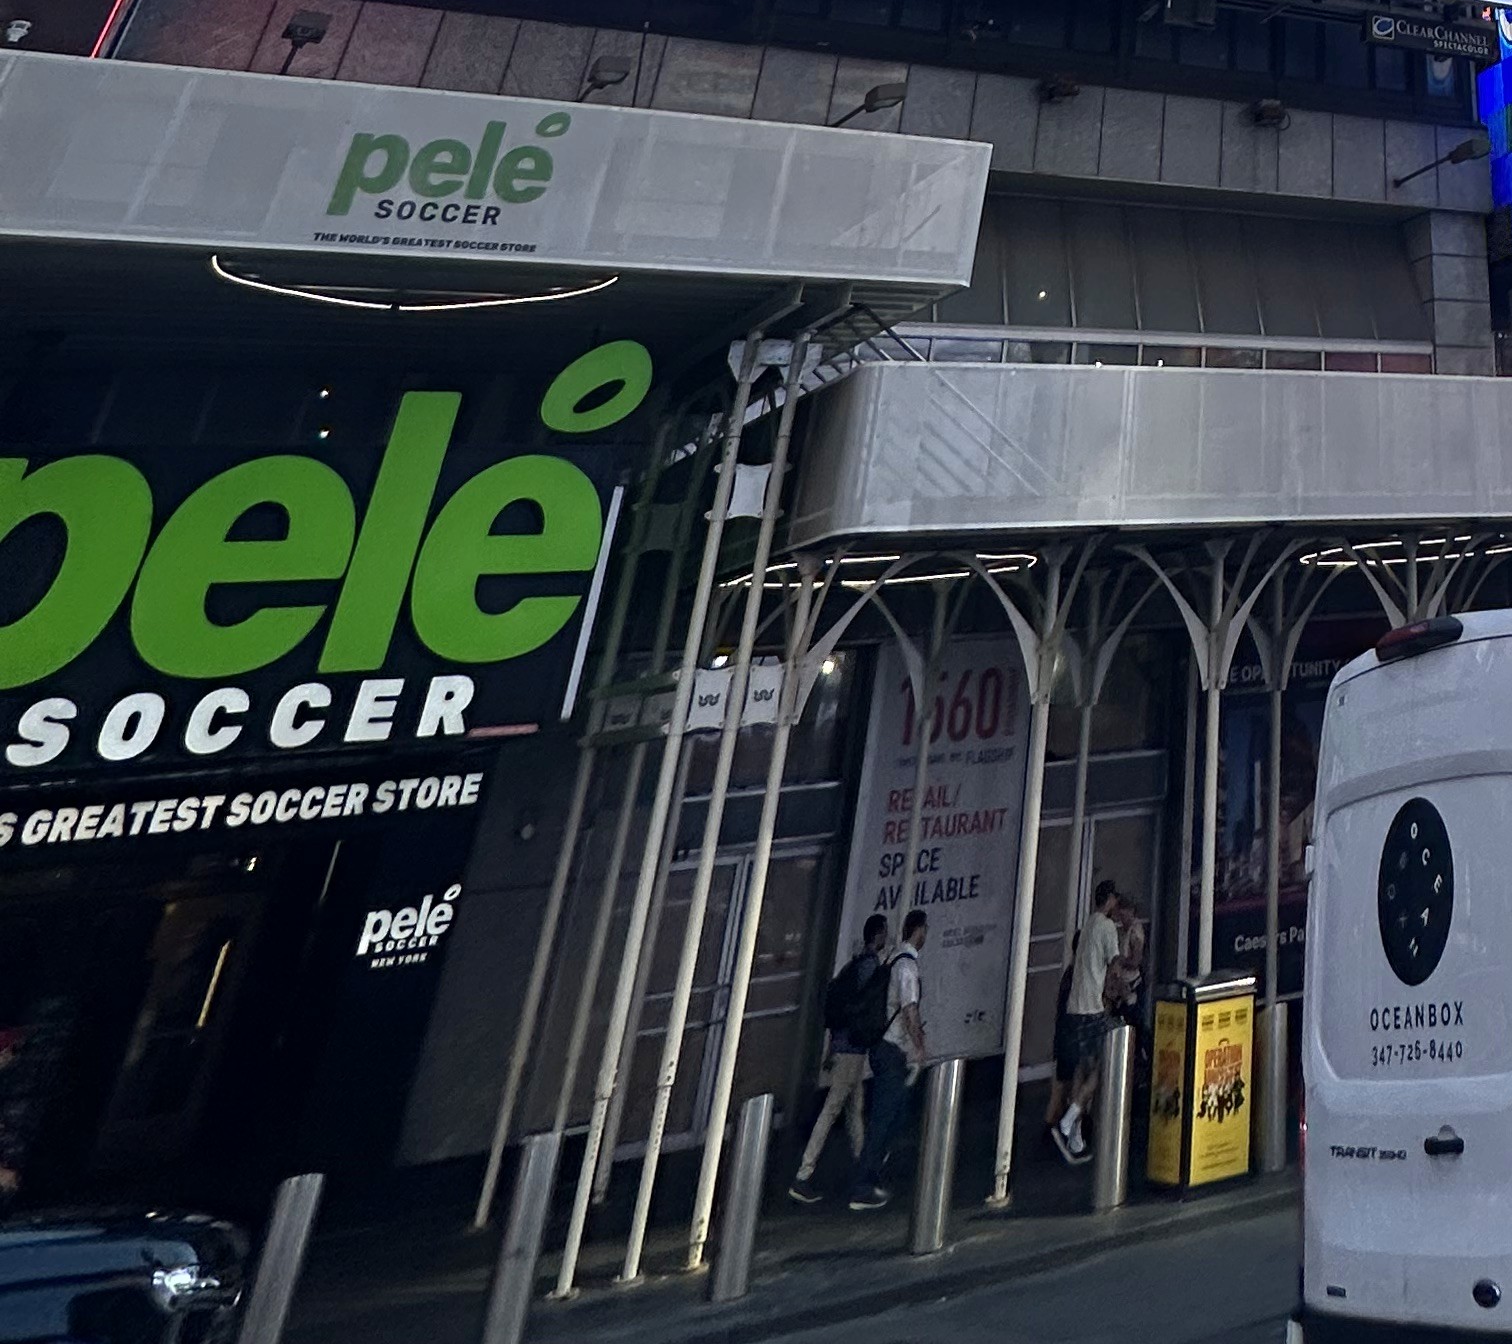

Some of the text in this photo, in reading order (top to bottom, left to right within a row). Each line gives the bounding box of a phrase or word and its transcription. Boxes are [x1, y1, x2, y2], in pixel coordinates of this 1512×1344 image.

[326, 111, 572, 217] pelé
[373, 198, 502, 226] SOCCER
[313, 231, 537, 253] THE WORLD'S GREATEST SOCCER STORE
[0, 340, 653, 690] pelé
[5, 673, 477, 768] SOCCER
[21, 793, 228, 847] GREATEST
[225, 781, 370, 829] SOCCER
[371, 772, 484, 814] STORE
[888, 781, 961, 813] REAIL/
[882, 808, 1009, 847] RETAURANT
[878, 847, 942, 878] SPCE
[355, 883, 462, 957] pelé
[374, 934, 440, 954] SOCCER
[371, 951, 429, 970] NEW YORK
[1369, 1000, 1465, 1032] OCEANBOX
[1371, 1038, 1464, 1068] 347-726-8440
[1329, 1144, 1378, 1161] TRANSIT
